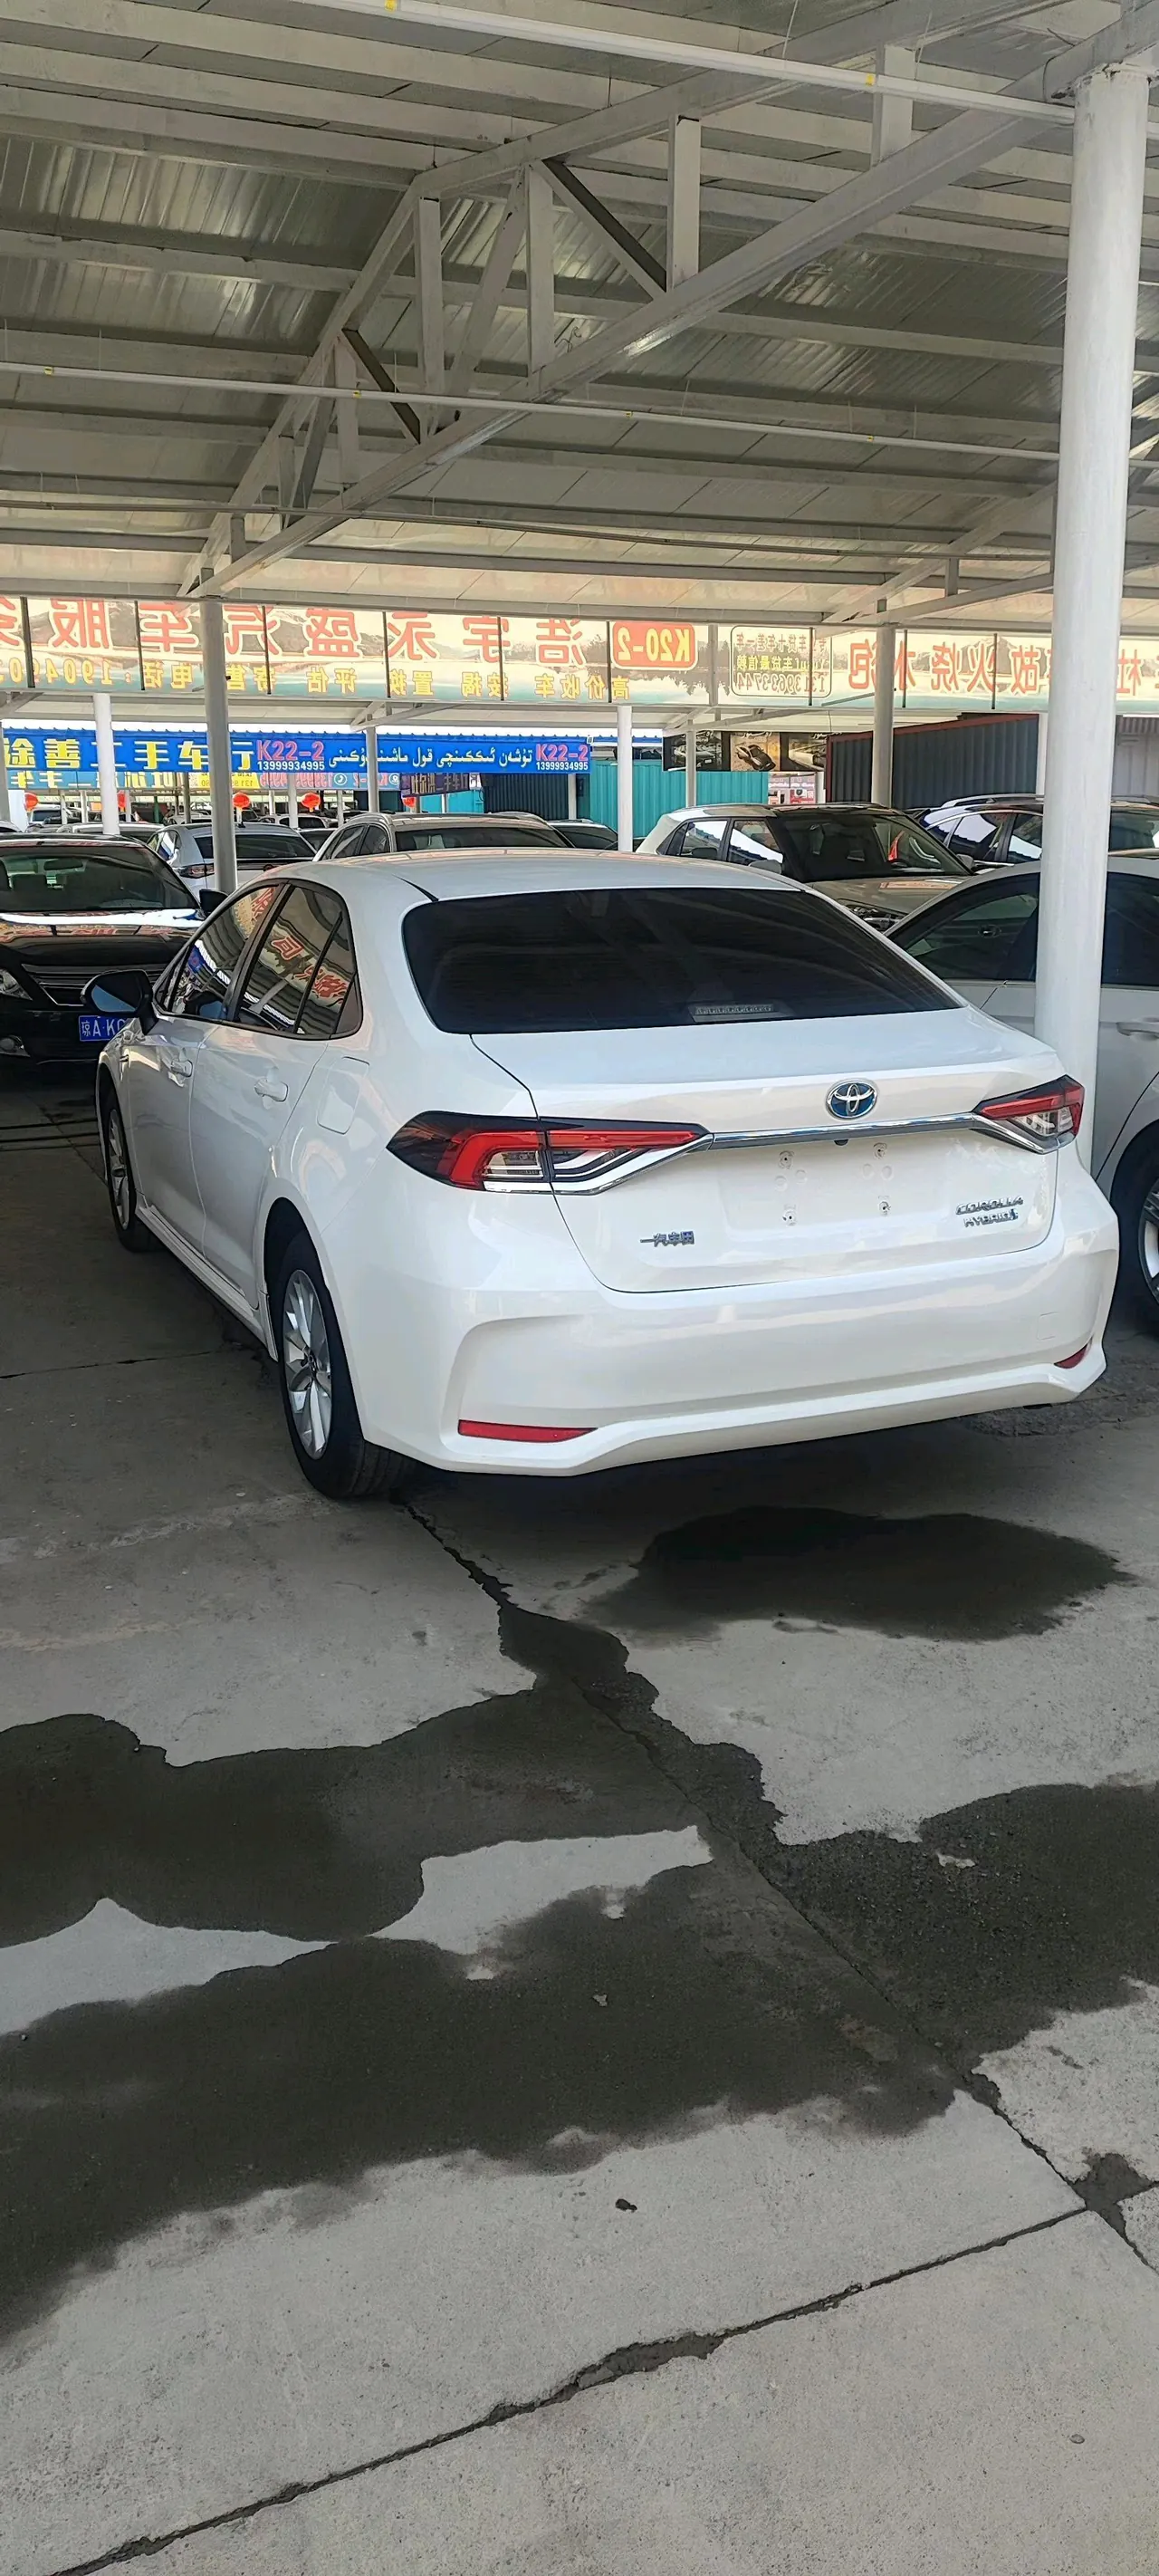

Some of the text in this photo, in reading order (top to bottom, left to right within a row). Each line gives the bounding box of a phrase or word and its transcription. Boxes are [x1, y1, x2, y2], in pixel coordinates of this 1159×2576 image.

[256, 739, 325, 762] K22-2
[536, 743, 589, 762] K22-2
[257, 761, 325, 771] 13999934995
[536, 761, 589, 771] 13999934995
[955, 1195, 1023, 1215] COROLLA
